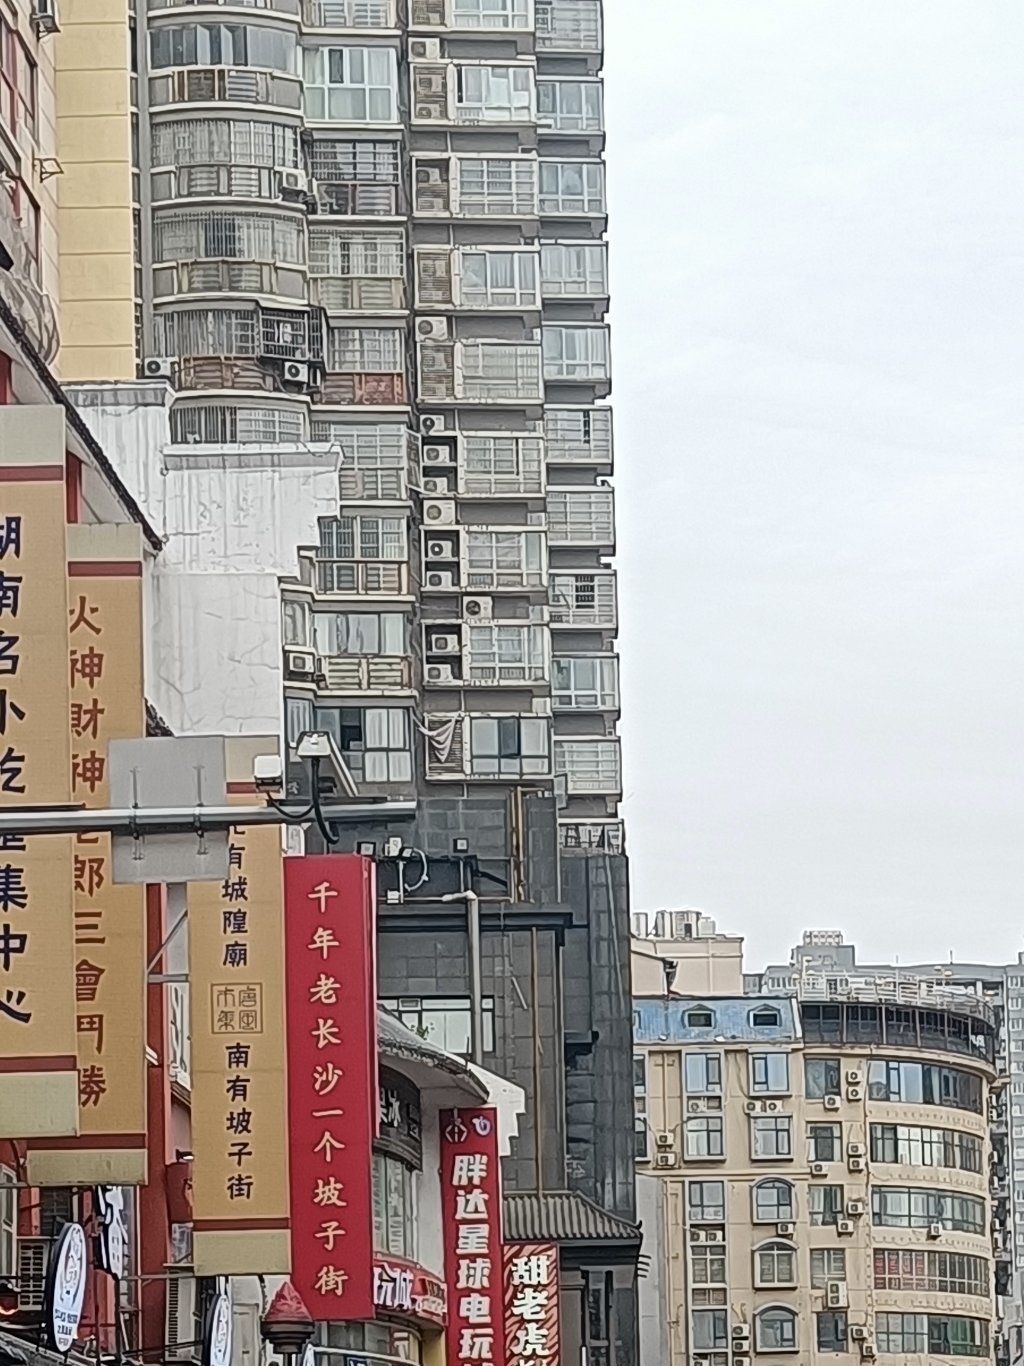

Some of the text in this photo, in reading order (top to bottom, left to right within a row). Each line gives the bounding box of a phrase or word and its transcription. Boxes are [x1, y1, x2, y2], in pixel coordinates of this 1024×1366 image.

[225, 1042, 254, 1200] 南有坡子街
[308, 881, 348, 1296] 千年老长沙一个坡子街
[511, 1256, 549, 1355] 甜老虎
